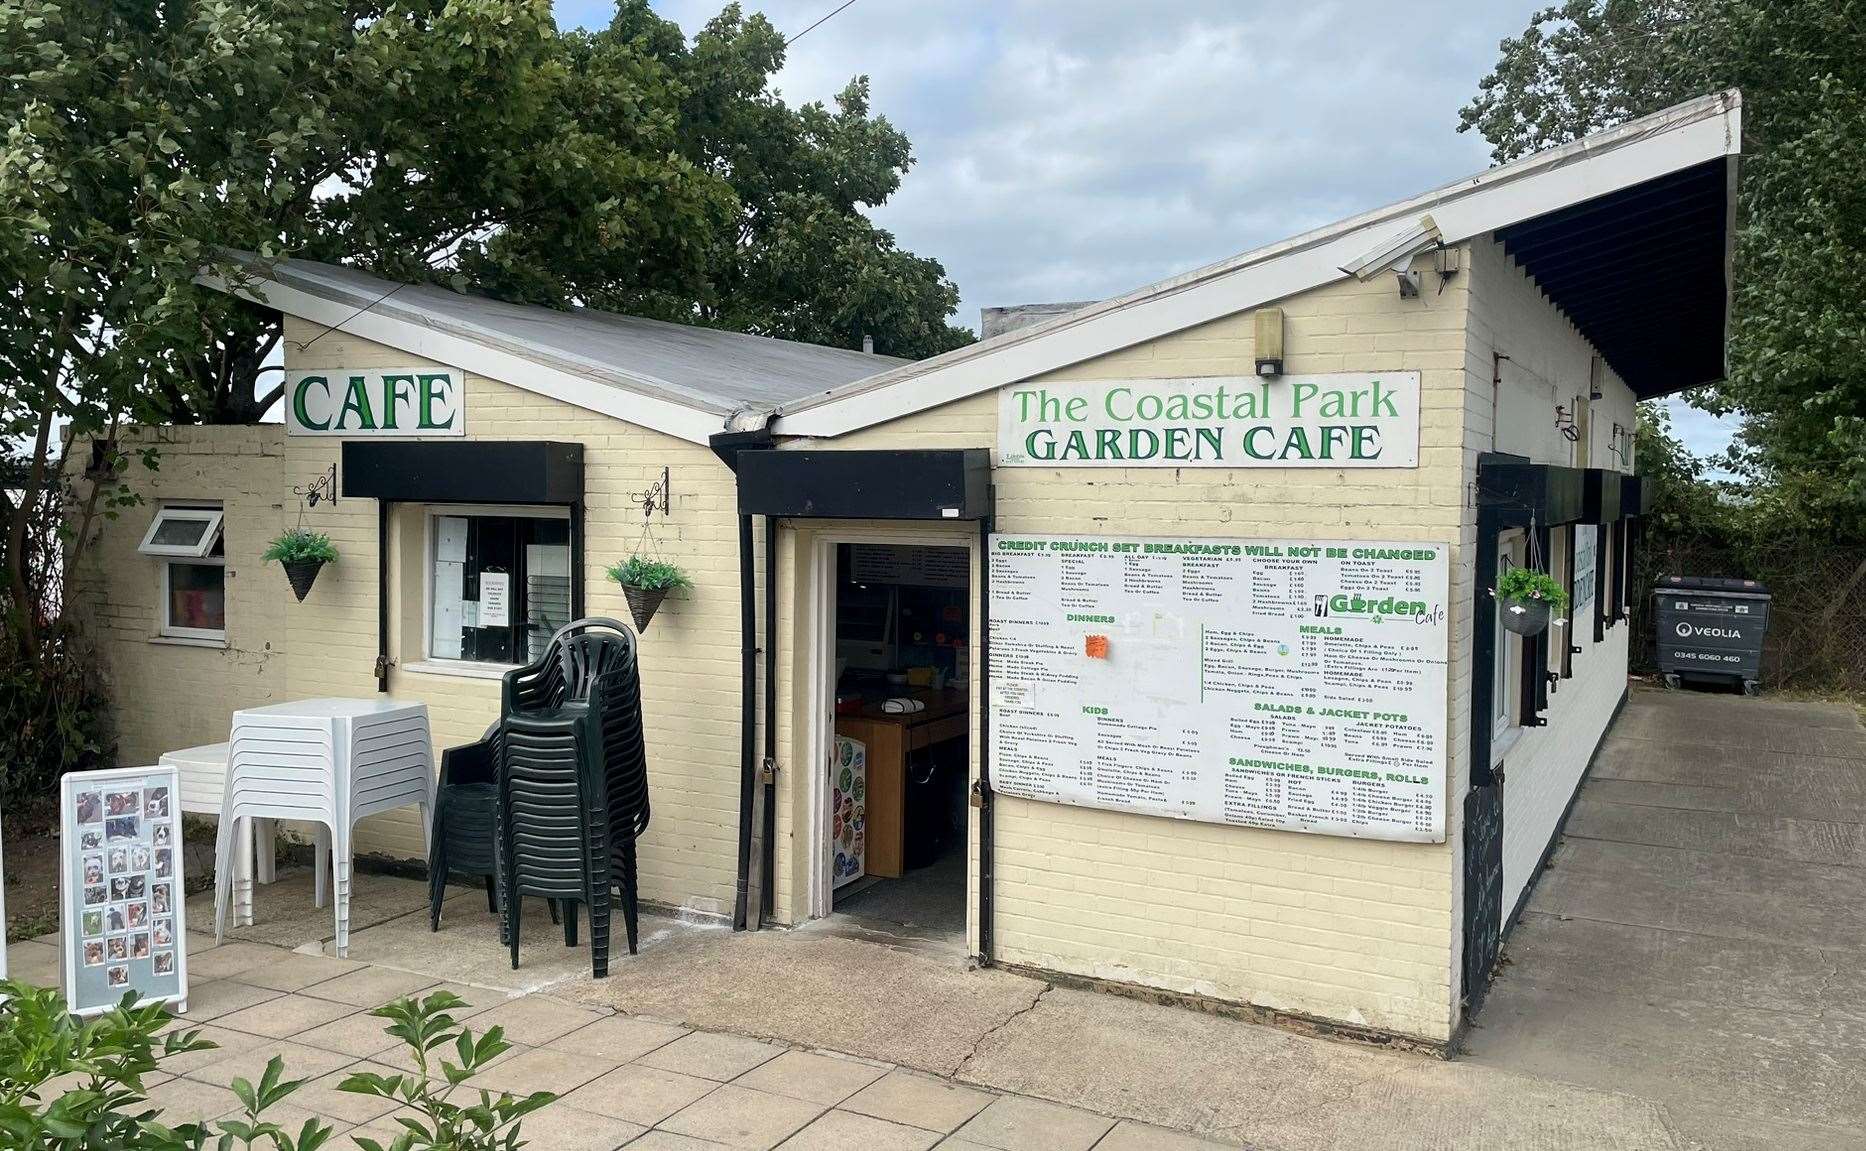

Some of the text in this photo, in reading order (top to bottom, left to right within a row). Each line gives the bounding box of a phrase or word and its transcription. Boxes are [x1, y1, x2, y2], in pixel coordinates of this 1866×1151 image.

[294, 374, 455, 431] CAFE
[1012, 380, 1400, 423] The Coastal Park
[1025, 424, 1383, 461] GARDEN CAFE
[997, 540, 1436, 560] CREDIT CRUNCH SET BREAKFASTS WILL NOT BE CHANGED
[1066, 613, 1115, 623] DINNERS
[1299, 624, 1342, 634] MEALS
[1694, 626, 1741, 639] VEOLIA
[1674, 651, 1697, 660] 0345
[1723, 654, 1741, 663] 460
[1082, 705, 1108, 715] KIDS
[1254, 702, 1302, 714] SALADS
[1318, 707, 1370, 719] JACKET
[1373, 711, 1408, 722] POTS
[1228, 757, 1429, 785] SANDWICHES, BURGERS, ROLLS
